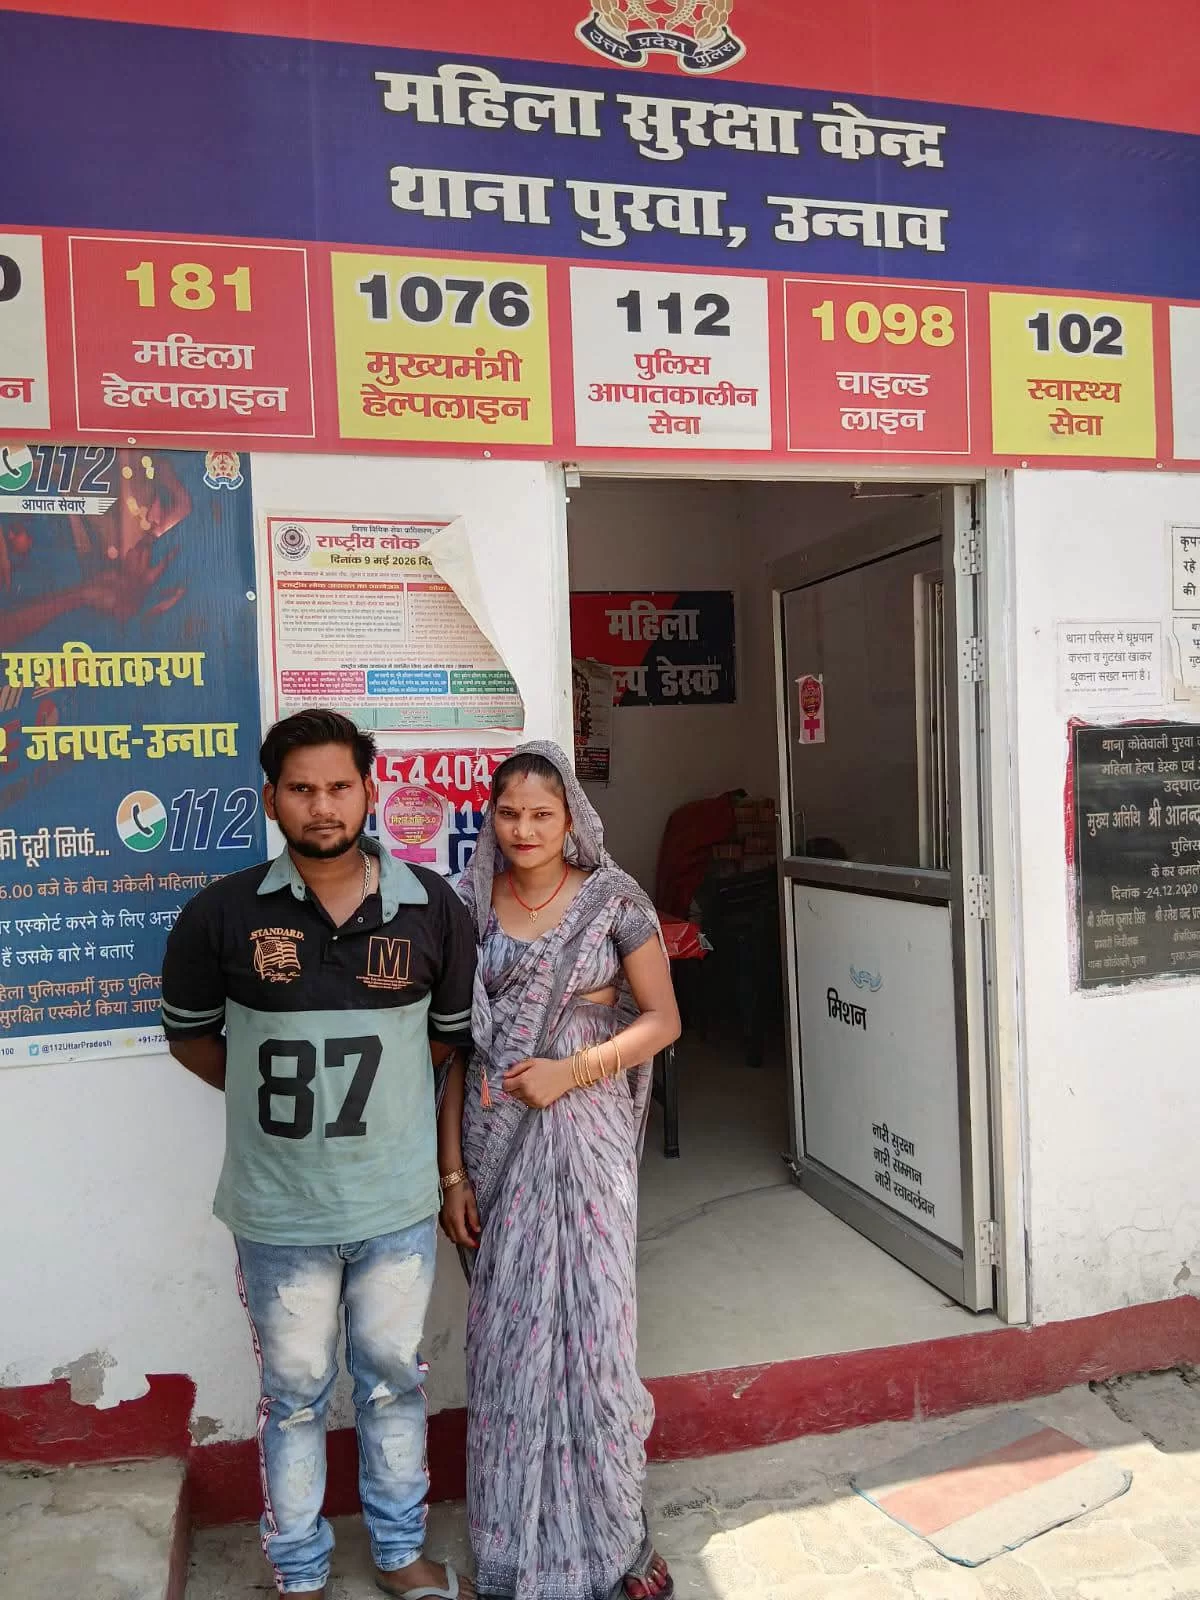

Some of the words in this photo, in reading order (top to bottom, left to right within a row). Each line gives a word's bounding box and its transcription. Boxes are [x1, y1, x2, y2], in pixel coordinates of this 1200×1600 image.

[590, 29, 630, 59] उत्तर
[636, 33, 686, 52] प्रदेश
[694, 41, 736, 68] पुलिस
[374, 64, 604, 138] महिला
[616, 93, 803, 162] सुरक्षा
[813, 101, 947, 169] केन्द्र
[390, 165, 554, 225] थाना
[566, 179, 747, 249] पुरवा,
[767, 195, 948, 253] उन्नाव
[125, 261, 253, 313] 181
[358, 274, 531, 327] 1076
[616, 290, 731, 338] 112
[811, 300, 955, 347] 1098
[132, 333, 256, 371] महिला
[1028, 312, 1124, 355] 102
[364, 347, 523, 386] मुख्यमंत्री
[633, 348, 710, 380] पुलिस
[101, 372, 289, 416] हेल्पलाइन
[588, 380, 758, 408] आपातकालीन
[836, 370, 930, 398] चाइल्ड
[1026, 378, 1122, 404] स्वास्थ्य
[361, 384, 531, 424] हेल्पलाइन
[647, 410, 701, 435] सेवा
[840, 408, 925, 434] लाइन
[1048, 407, 1103, 437] सेवा
[35, 446, 117, 494] 112
[22, 498, 55, 513] आपात
[57, 496, 86, 513] सेवाएं
[316, 533, 375, 552] राष्ट्रीय
[380, 535, 421, 550] लोक
[330, 554, 363, 565] दिनांक
[364, 556, 371, 565] 9
[373, 555, 391, 566] मई
[392, 557, 417, 566] 2026
[1183, 582, 1197, 596] की
[605, 600, 701, 641] महिला
[1066, 633, 1086, 644] थाना
[1088, 630, 1115, 644] परिसर
[1126, 632, 1154, 647] धूम्रपान
[1, 641, 206, 688] सशक्तिकरण
[656, 655, 722, 697] डेस्क
[1067, 653, 1091, 663] करना
[1102, 652, 1126, 666] गुटखा
[1127, 651, 1152, 662] खाकर
[1070, 672, 1096, 687] थूकना
[1098, 671, 1120, 682] सख्त
[1122, 671, 1137, 681] मना
[22, 723, 239, 761] जनपद-उन्नाव
[1171, 737, 1194, 752] पुरवा
[1101, 760, 1132, 776] महिला
[1134, 758, 1155, 774] हेल्प
[1157, 757, 1178, 773] डेस्क
[1180, 755, 1195, 772] एवं
[170, 787, 258, 851] 112
[1086, 812, 1109, 836] मुख्य
[1148, 797, 1161, 828] श्री
[20, 827, 51, 867] दूरी
[37, 878, 61, 896] बजे
[64, 876, 79, 895] के
[82, 875, 108, 894] बीच
[112, 873, 155, 893] अकेली
[158, 871, 208, 892] महिलाएं
[1151, 863, 1160, 877] के
[1162, 866, 1175, 878] कर
[1111, 884, 1140, 901] दिनांक
[15, 912, 62, 936] एस्कोर्ट
[65, 910, 98, 930] करने
[100, 909, 115, 928] के
[119, 908, 145, 929] लिए
[1, 946, 13, 967] हैं
[16, 944, 54, 965] उसके
[57, 942, 81, 963] बारे
[84, 941, 97, 960] में
[99, 940, 135, 960] बताएं
[368, 936, 411, 980] M
[28, 976, 95, 1003] पुलिसकर्मी
[98, 978, 124, 997] युक्त
[827, 987, 867, 1030] मिशन
[0, 1005, 44, 1028] सुरक्षित
[48, 1000, 91, 1021] एस्कोर्ट
[95, 998, 128, 1017] किया
[258, 1035, 383, 1139] 87
[872, 1122, 889, 1143] नारी
[891, 1132, 915, 1157] सुरक्षा
[873, 1147, 891, 1168] नारी
[892, 1157, 922, 1185] सम्मान
[875, 1171, 892, 1193] नारी
[893, 1180, 935, 1218] स्वावलंबन
